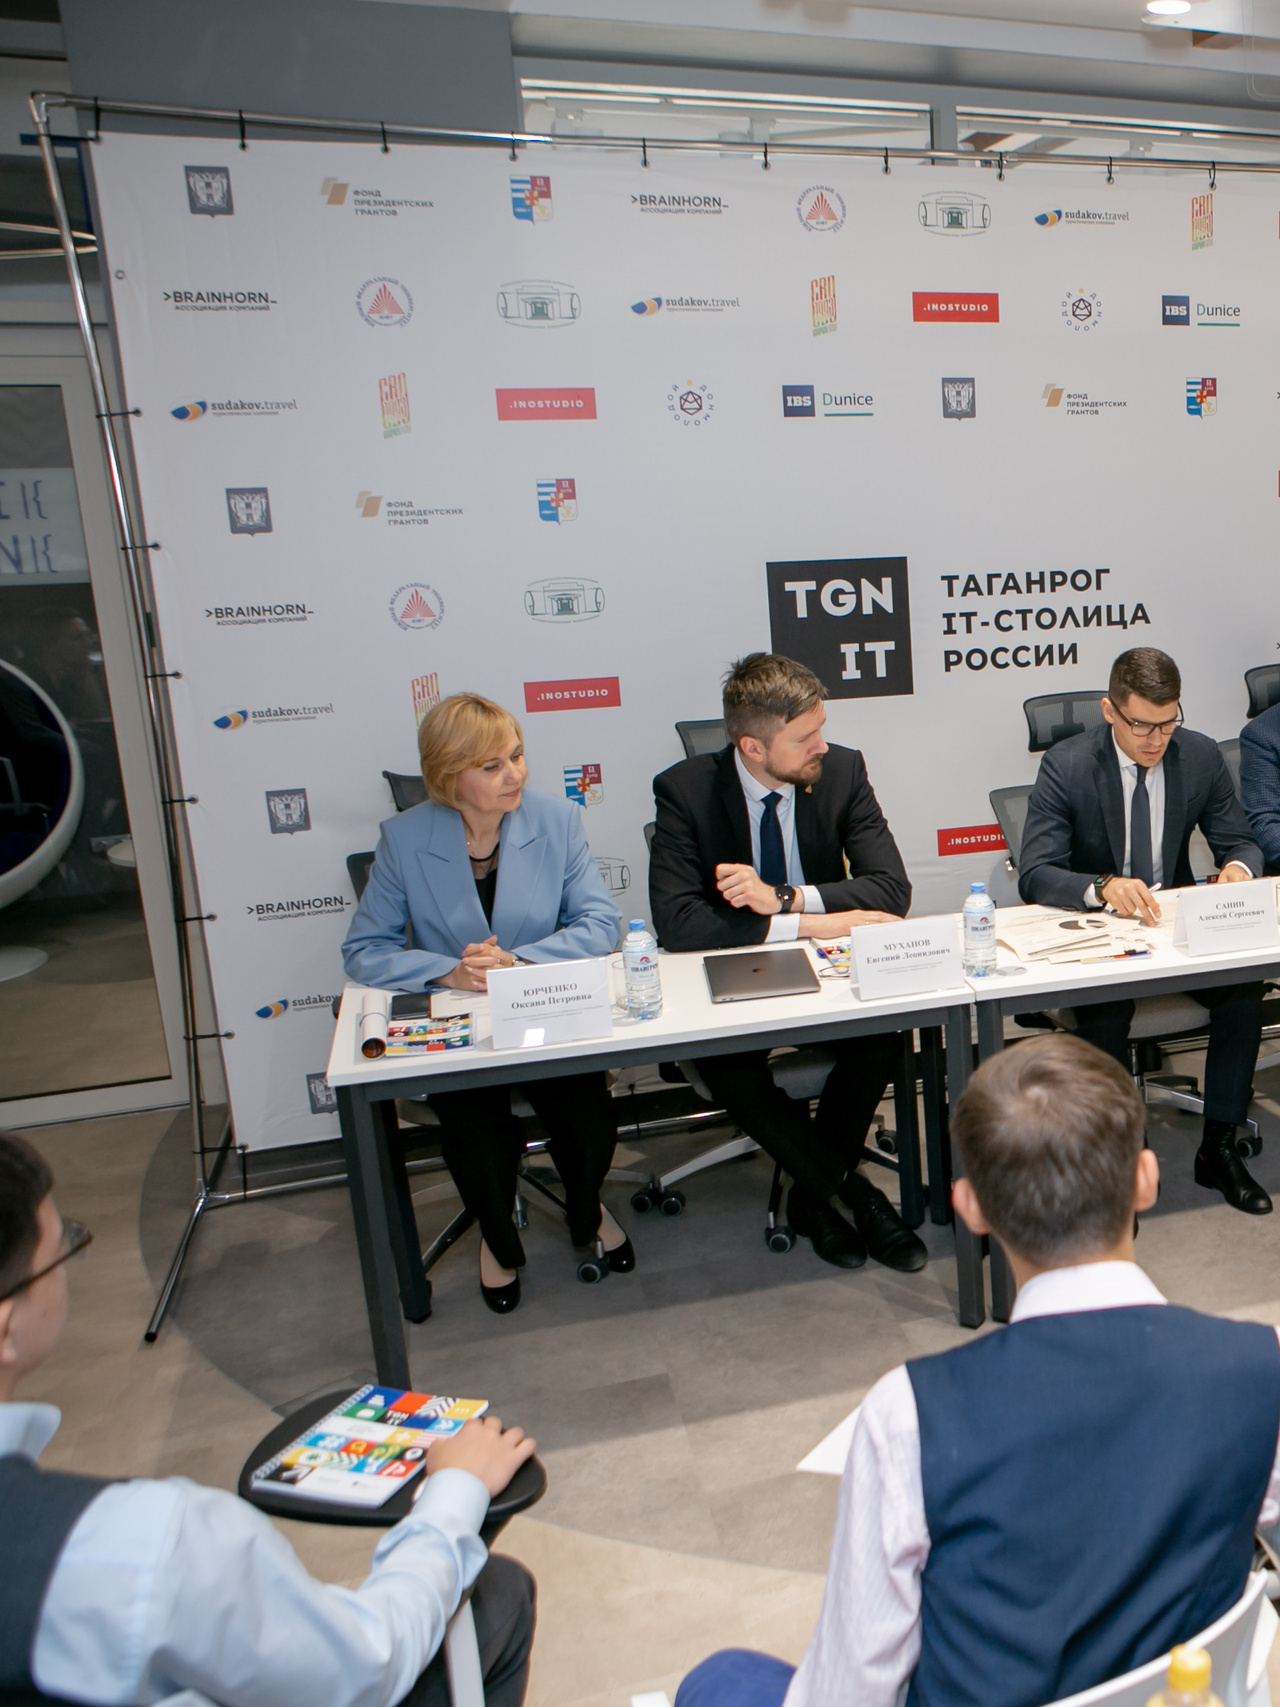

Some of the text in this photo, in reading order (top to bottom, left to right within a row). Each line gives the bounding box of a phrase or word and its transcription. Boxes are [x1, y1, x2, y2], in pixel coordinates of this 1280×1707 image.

[353, 189, 382, 198] ФОНД
[354, 199, 434, 208] ПРЕЗИДЕНТСКИХ
[355, 208, 398, 216] ГРАНТОВ
[1065, 209, 1130, 221] sudakov.travel
[665, 296, 740, 307] sudakov.travel
[1165, 303, 1241, 317] IBS Dunice
[211, 399, 298, 412] sudakov.travel
[786, 392, 874, 407] IBS Dunice
[386, 501, 414, 509] ФОНД
[387, 508, 464, 518] ПРЕЗИДЕНТСКИХ
[388, 518, 429, 526] ГРАНТОВ
[941, 568, 1110, 598] ТАГАНРОГ
[784, 576, 894, 619] TGN
[942, 603, 1151, 636] IT-СТОЛИЦА
[840, 640, 896, 680] IT
[944, 642, 1079, 673] РОССИИ
[252, 703, 335, 719] sudakov.travel
[1198, 909, 1265, 922] Алексей Сергеевич
[884, 939, 931, 952] МУХАНОВ
[866, 949, 951, 965] Евгений Леонидович
[523, 983, 578, 997] ЮРЧЕНКО
[292, 994, 337, 1007] sudakov
[511, 993, 592, 1010] Оксана Петровна
